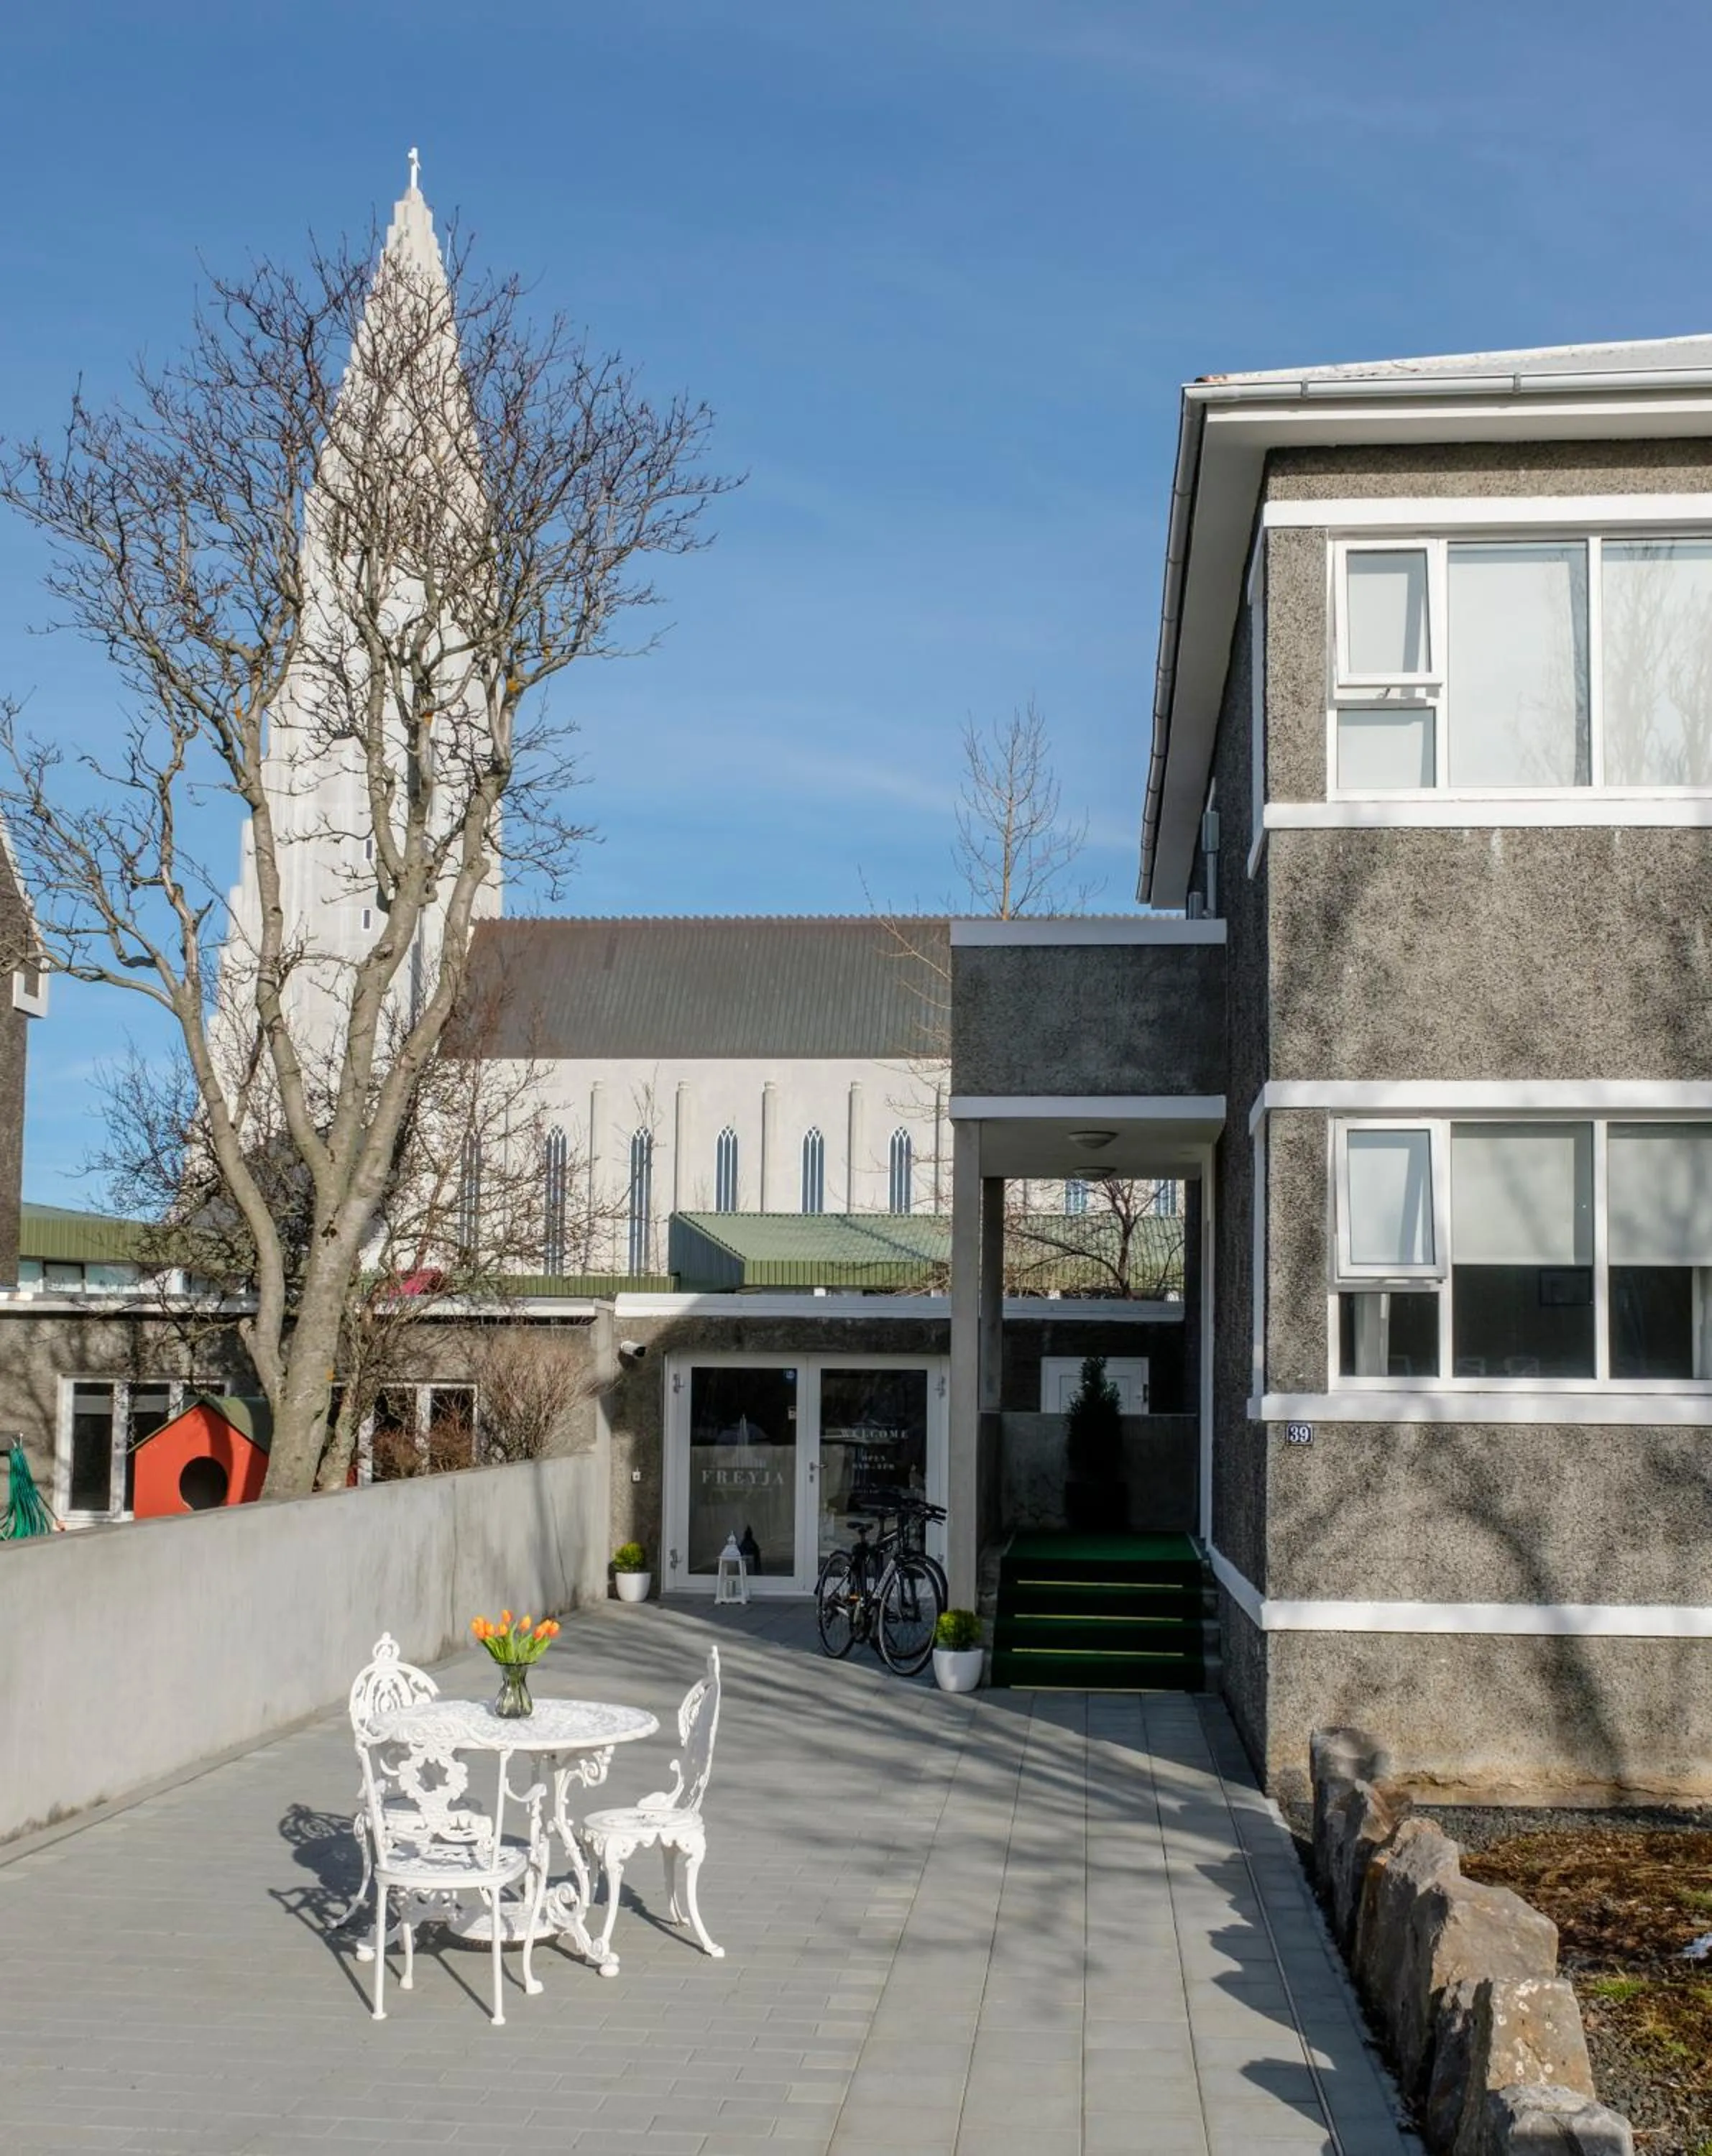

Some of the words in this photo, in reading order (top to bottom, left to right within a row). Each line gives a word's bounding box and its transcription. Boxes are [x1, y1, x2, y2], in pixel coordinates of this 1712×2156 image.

[839, 1429, 909, 1439] WELCOME
[1290, 1426, 1309, 1442] 39
[701, 1469, 785, 1485] FREYJA
